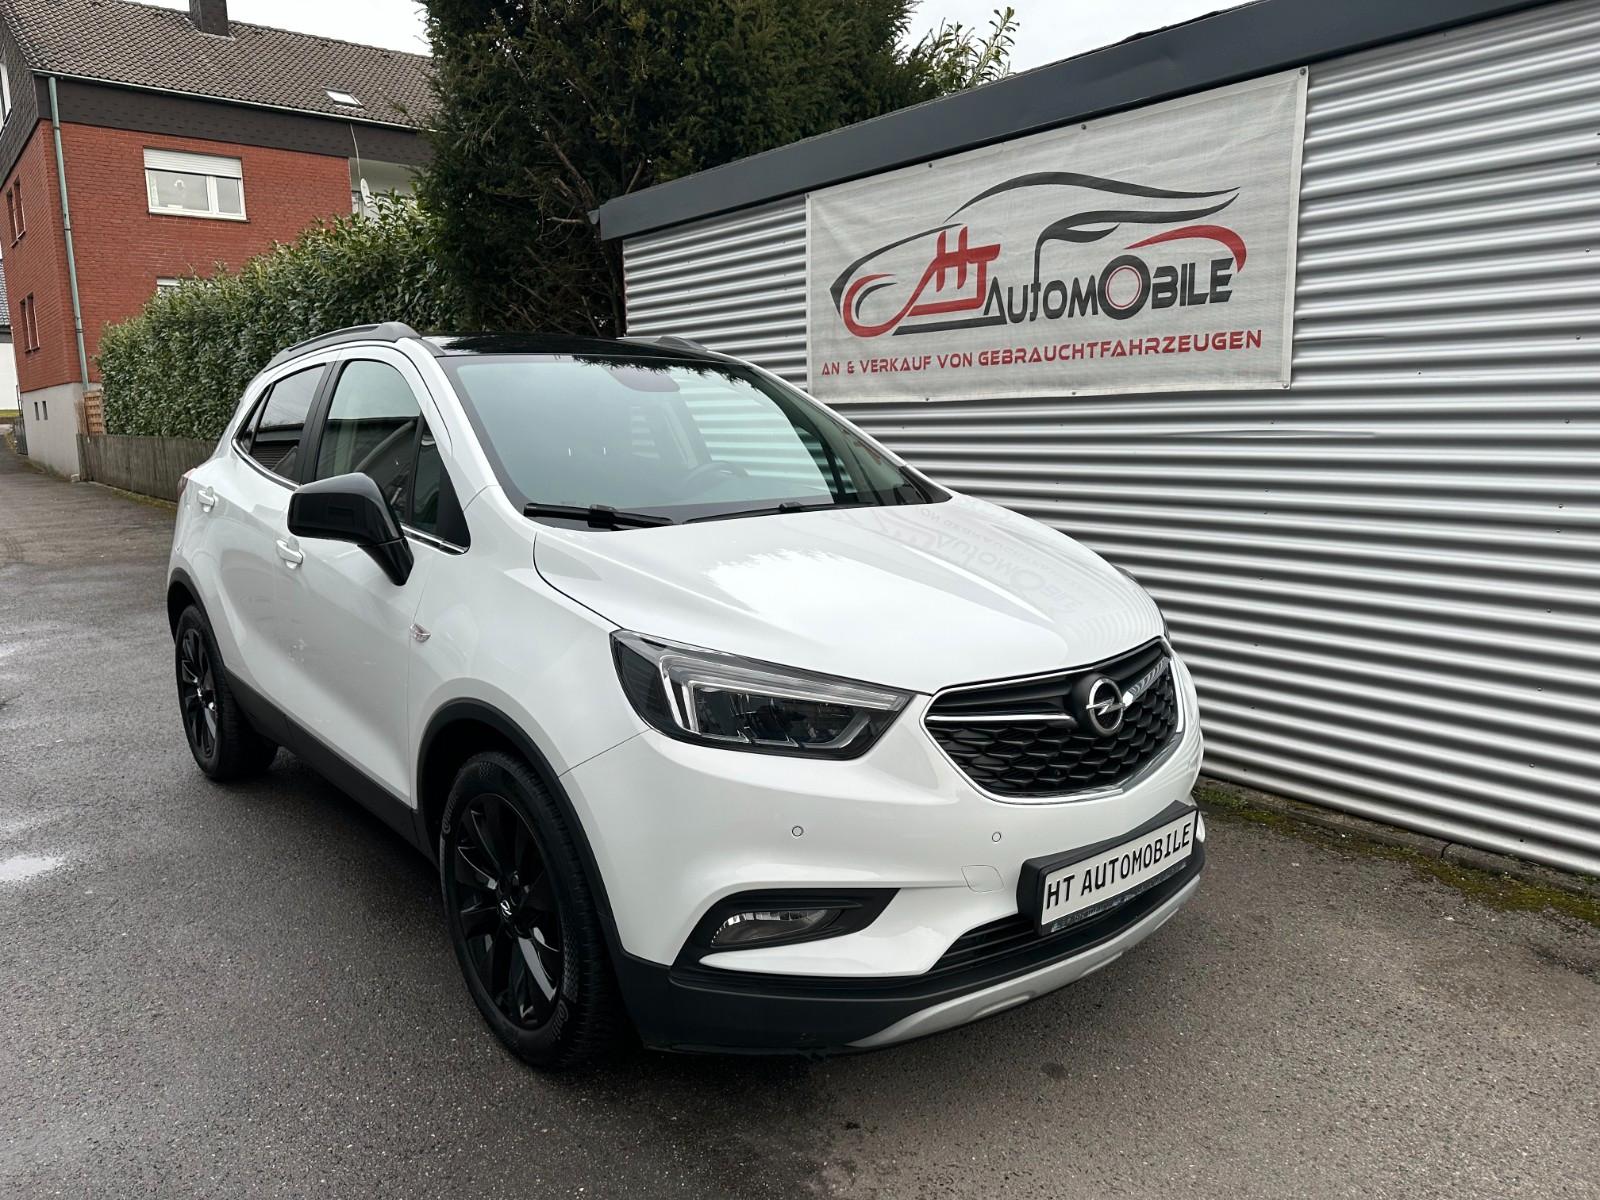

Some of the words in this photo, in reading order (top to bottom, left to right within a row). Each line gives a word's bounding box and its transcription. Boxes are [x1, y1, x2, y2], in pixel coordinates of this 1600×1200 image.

[821, 361, 840, 376] AN
[846, 360, 855, 374] &
[859, 355, 931, 373] VERKAUF
[937, 351, 973, 369] VON
[977, 329, 1262, 367] GEBRAUCHTFAHRZEUGEN
[1046, 874, 1075, 910] HT
[1080, 822, 1191, 896] AUTOMOBILE
